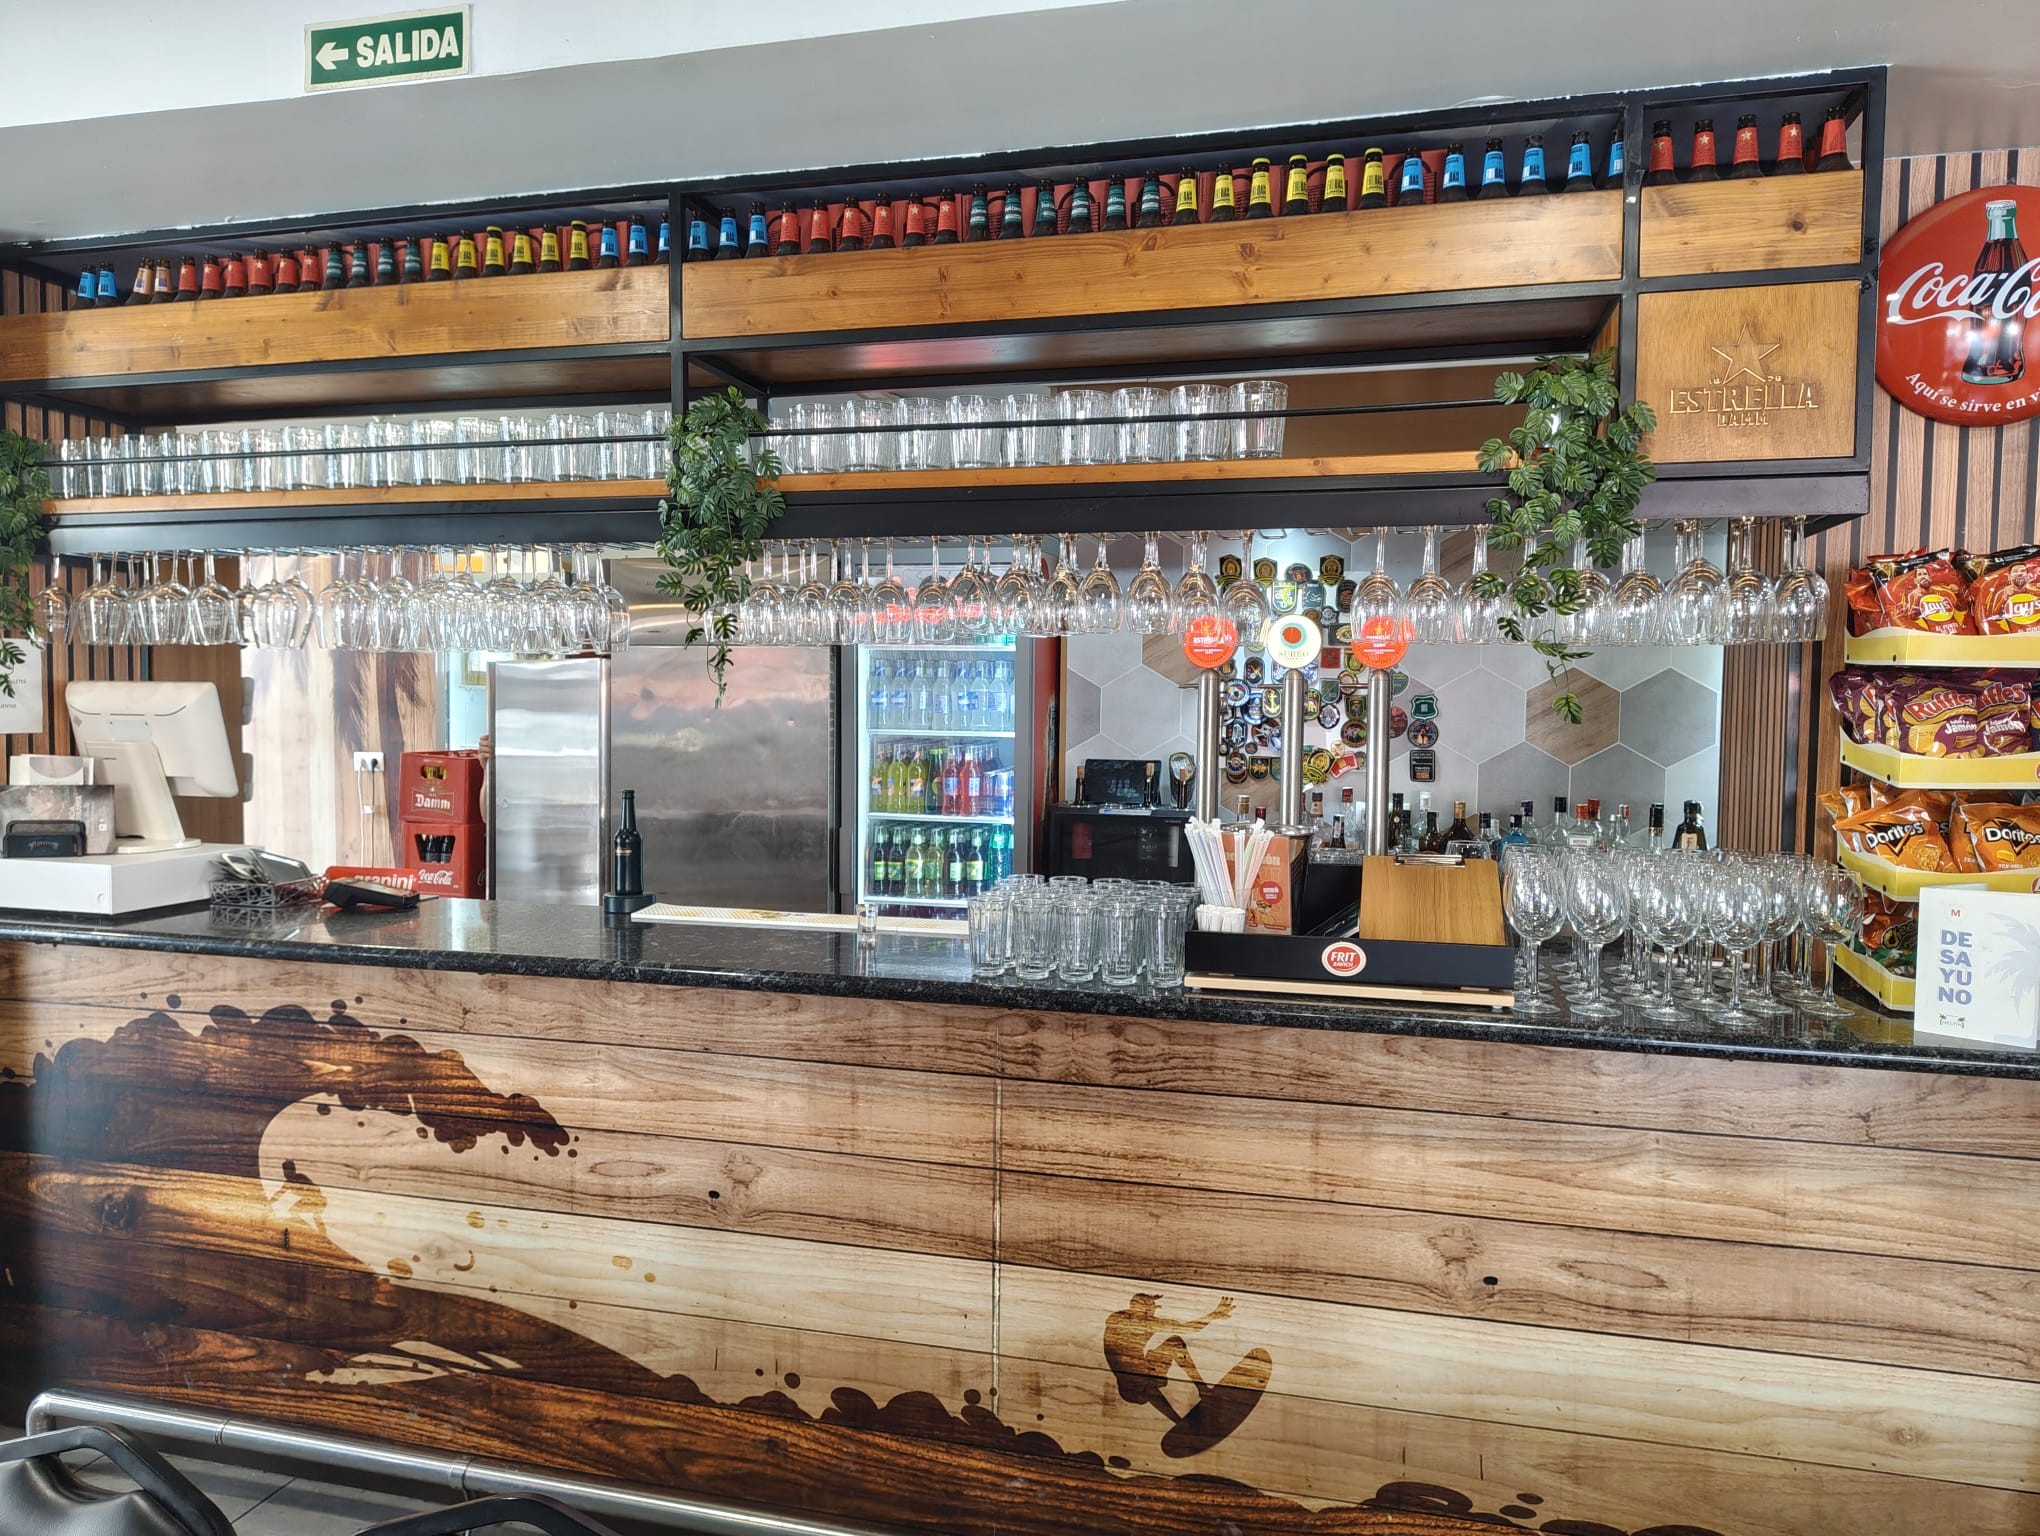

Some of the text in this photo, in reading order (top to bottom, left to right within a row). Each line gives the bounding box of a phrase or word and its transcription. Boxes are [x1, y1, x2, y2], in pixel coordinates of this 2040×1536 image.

[356, 26, 459, 68] SALIDA
[1669, 382, 1820, 414] ESTRELLA
[1905, 372, 1942, 401] Aquí
[1939, 394, 1958, 408] se
[1959, 401, 2001, 413] sirve
[2006, 396, 2027, 411] en
[1716, 411, 1769, 427] DAMM
[415, 794, 450, 809] Damm
[1865, 821, 1924, 849] Doritos
[1951, 909, 1961, 918] M
[1941, 930, 1973, 948] DE
[1330, 951, 1357, 962] FRIT
[1940, 949, 1972, 967] SA
[1940, 967, 1973, 986] YU
[1938, 986, 1973, 1005] NO
